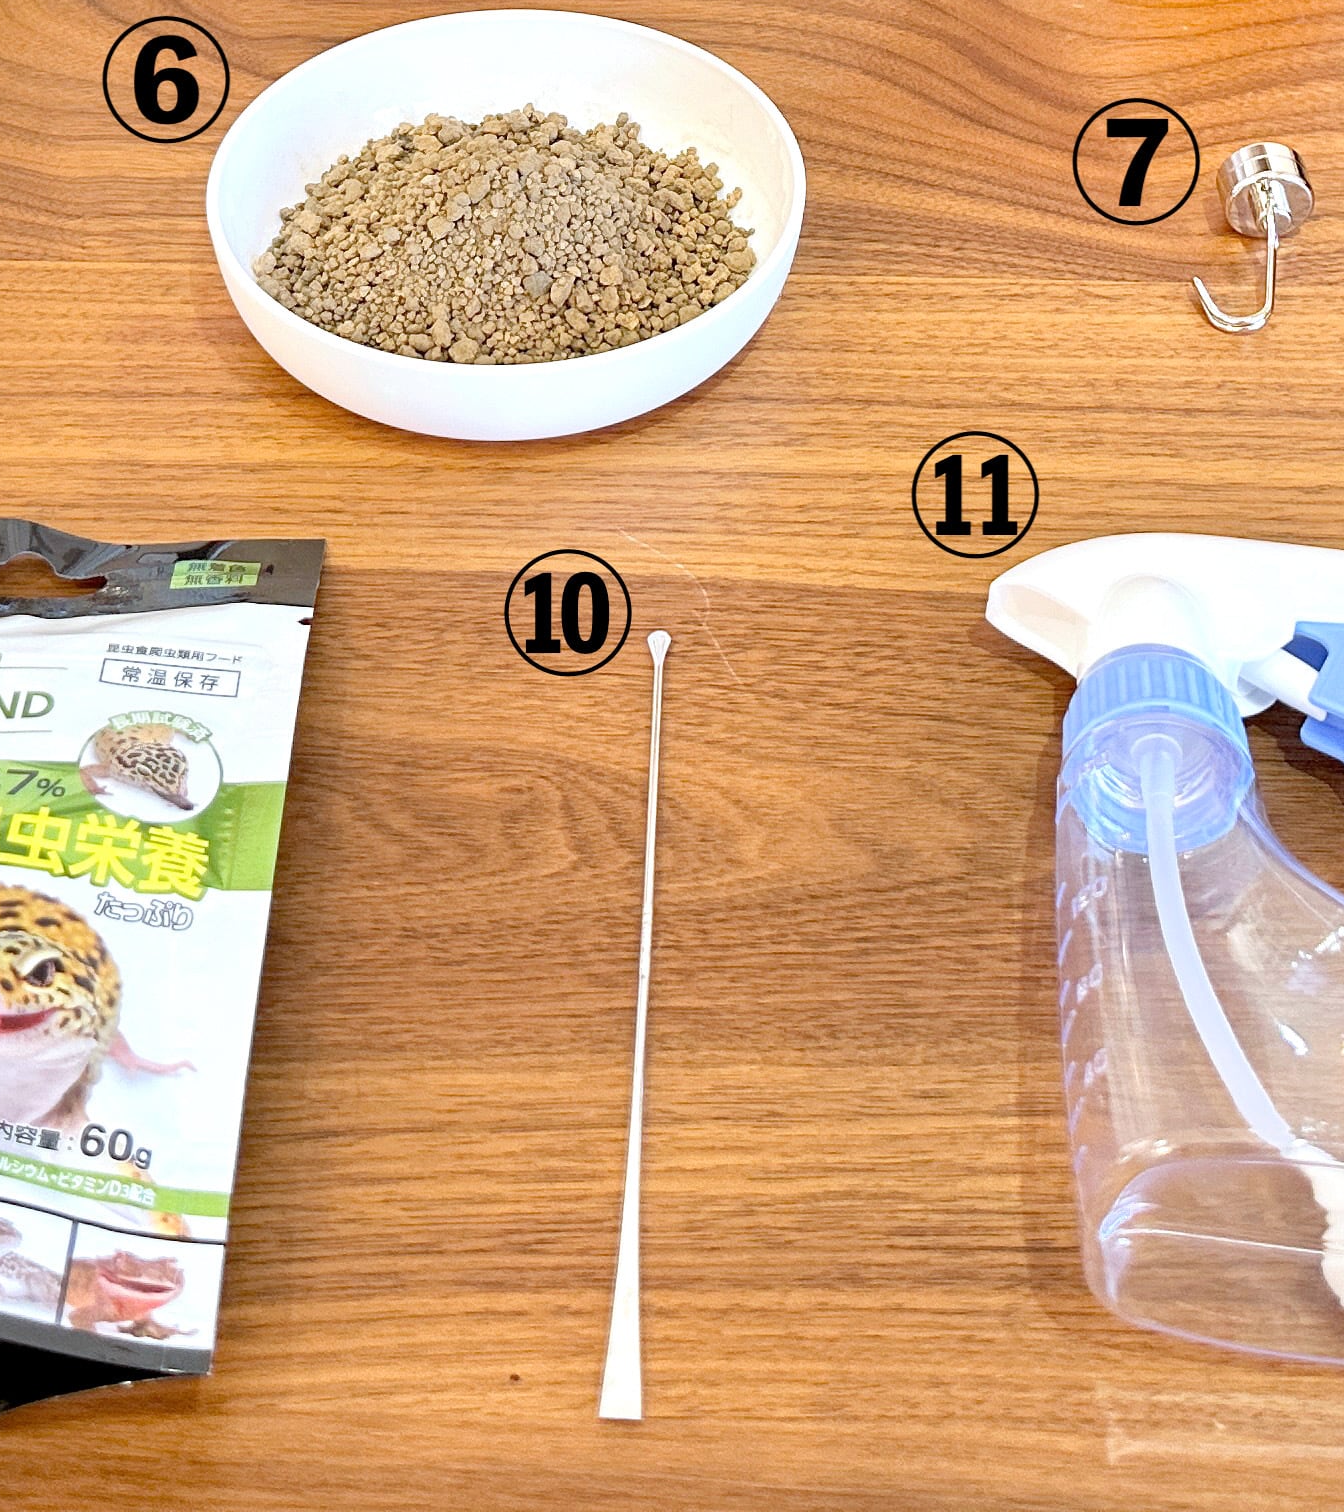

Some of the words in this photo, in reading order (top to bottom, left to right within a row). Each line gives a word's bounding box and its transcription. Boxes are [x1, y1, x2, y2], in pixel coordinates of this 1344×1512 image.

[121, 665, 221, 692] 常温保存
[94, 891, 195, 931] たっぷり
